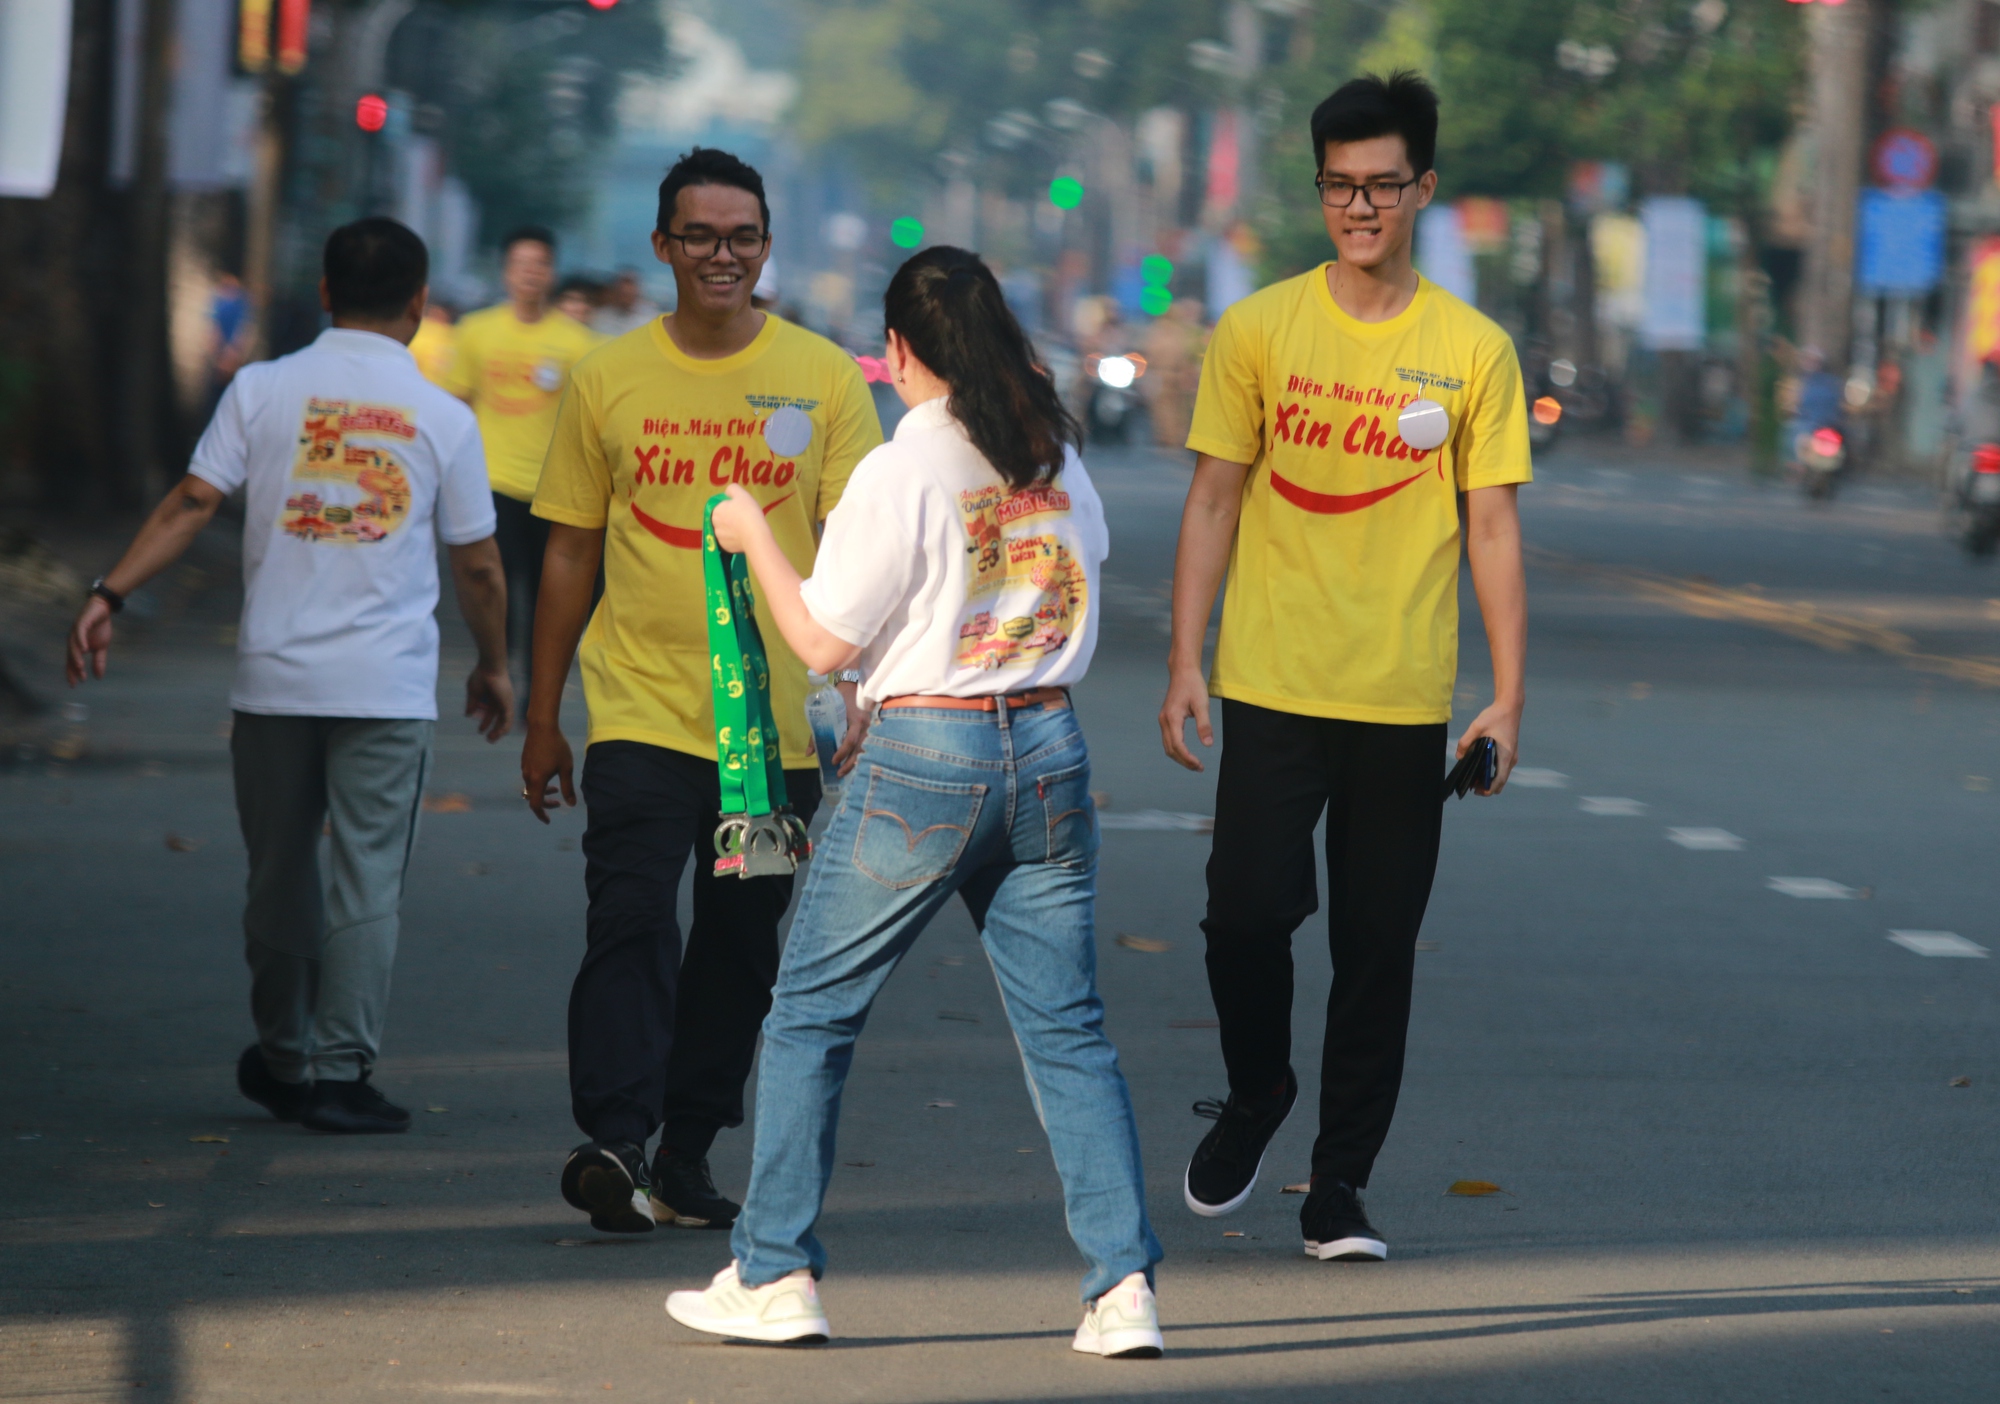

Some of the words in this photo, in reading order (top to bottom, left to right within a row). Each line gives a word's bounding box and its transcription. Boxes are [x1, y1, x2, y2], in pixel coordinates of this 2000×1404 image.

[1287, 375, 1323, 398] Điện
[1326, 382, 1364, 406] Máy
[1365, 387, 1397, 411] Chợ
[643, 419, 680, 438] Điện
[684, 418, 722, 439] Máy
[727, 418, 757, 439] Chợ
[1273, 401, 1332, 449] Xin
[634, 444, 695, 486] Xin
[995, 492, 1003, 505] 5
